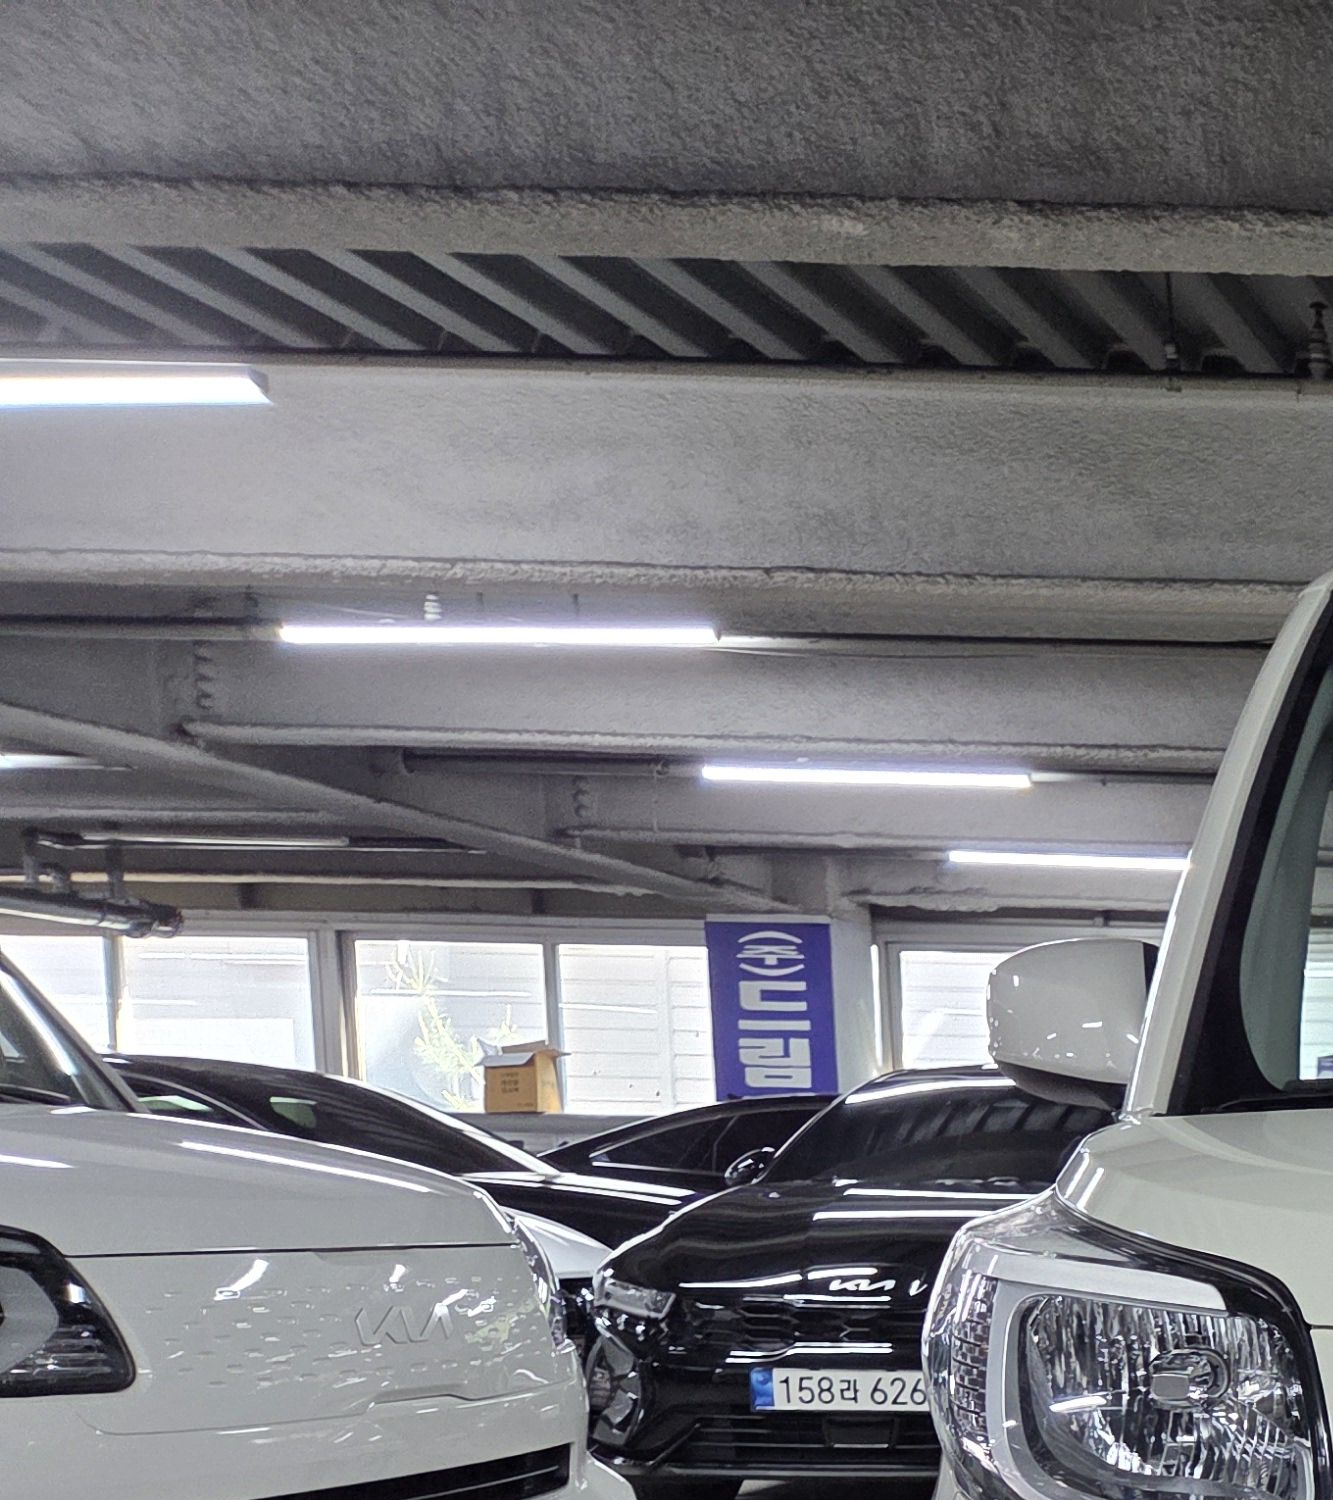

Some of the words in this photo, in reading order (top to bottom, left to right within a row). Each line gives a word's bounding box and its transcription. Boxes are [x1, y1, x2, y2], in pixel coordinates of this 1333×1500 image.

[736, 930, 813, 1090] (주)드림
[779, 1376, 860, 1404] 158라
[870, 1377, 926, 1405] 626
